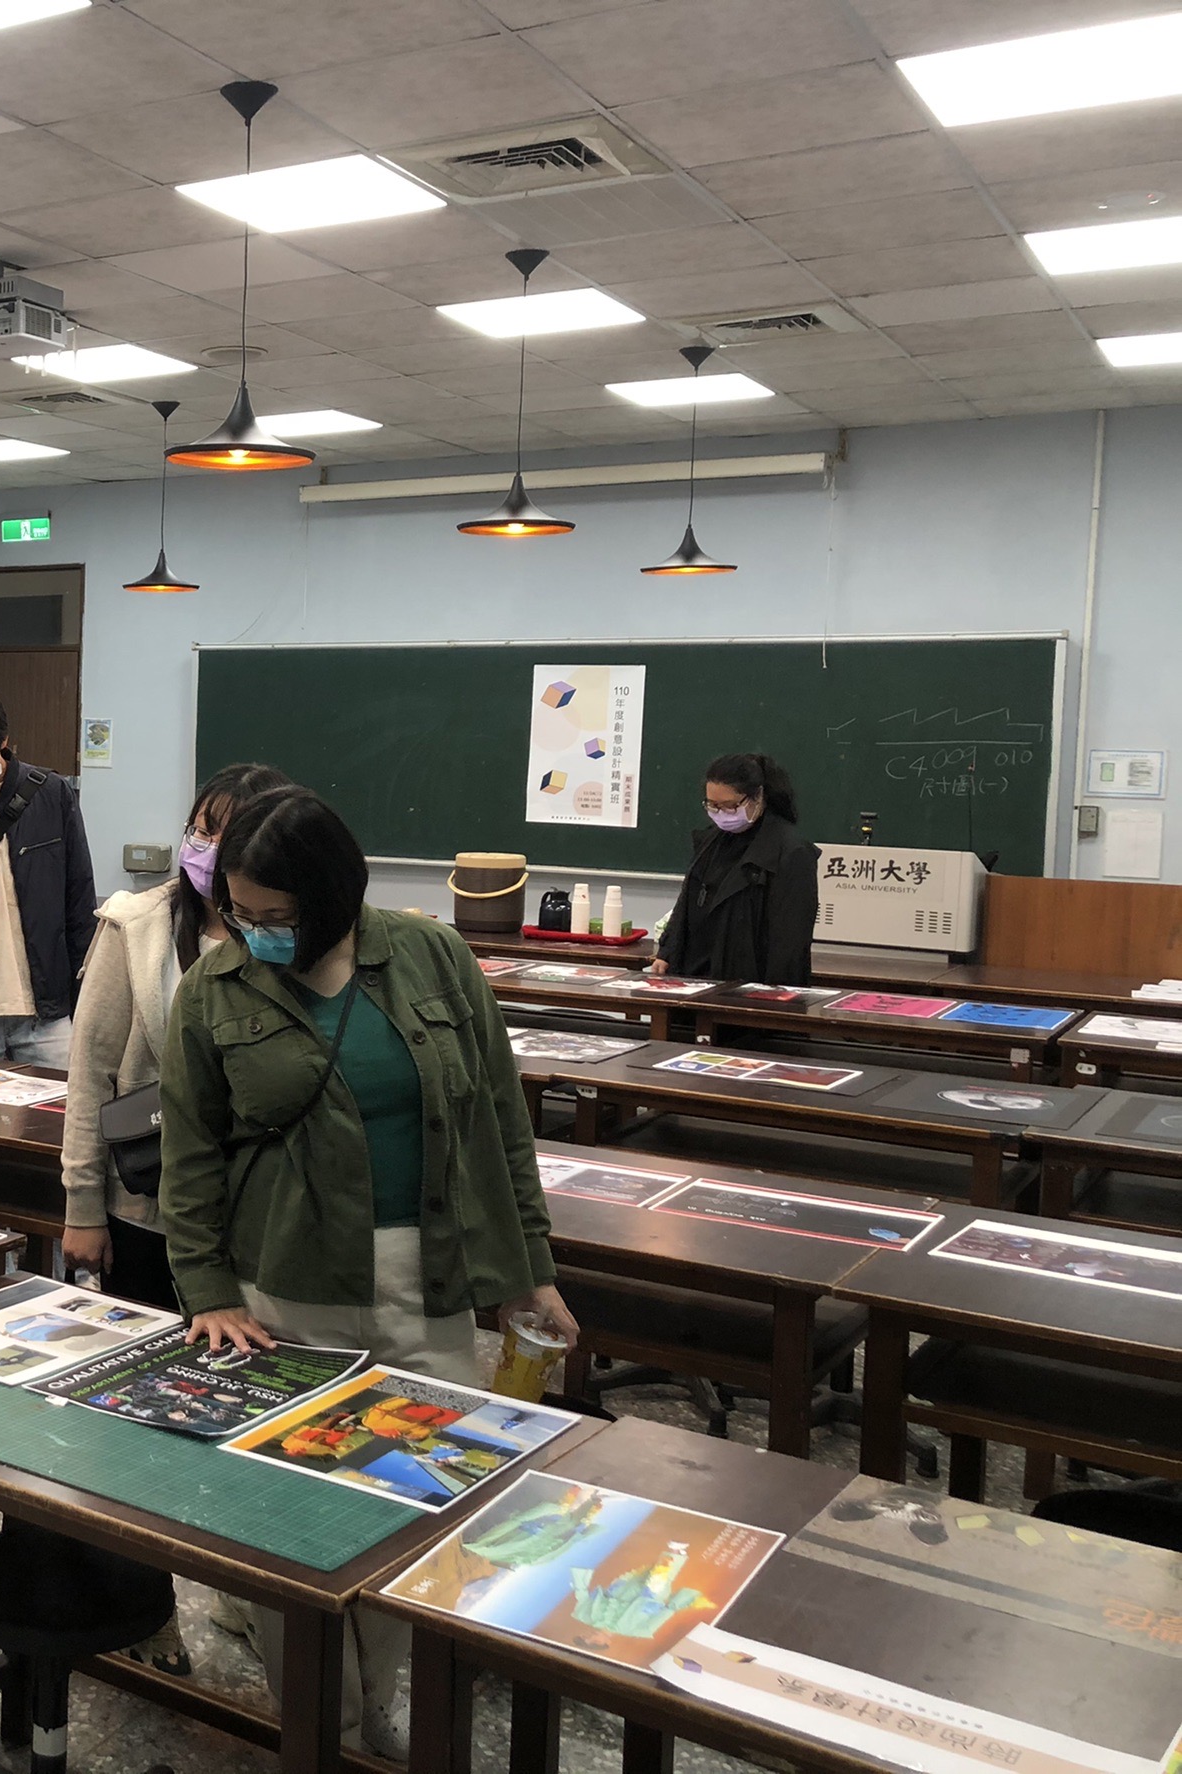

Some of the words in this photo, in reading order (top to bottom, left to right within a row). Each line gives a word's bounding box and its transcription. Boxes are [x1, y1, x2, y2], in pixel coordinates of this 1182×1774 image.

[823, 856, 931, 885] 亞洲大學
[835, 882, 857, 891] ASIA
[861, 884, 918, 894] UNIVERSITY
[48, 1348, 145, 1389] QUALITATIVE
[166, 1366, 218, 1385] CHING
[776, 1674, 1023, 1766] 時尚設計學系
